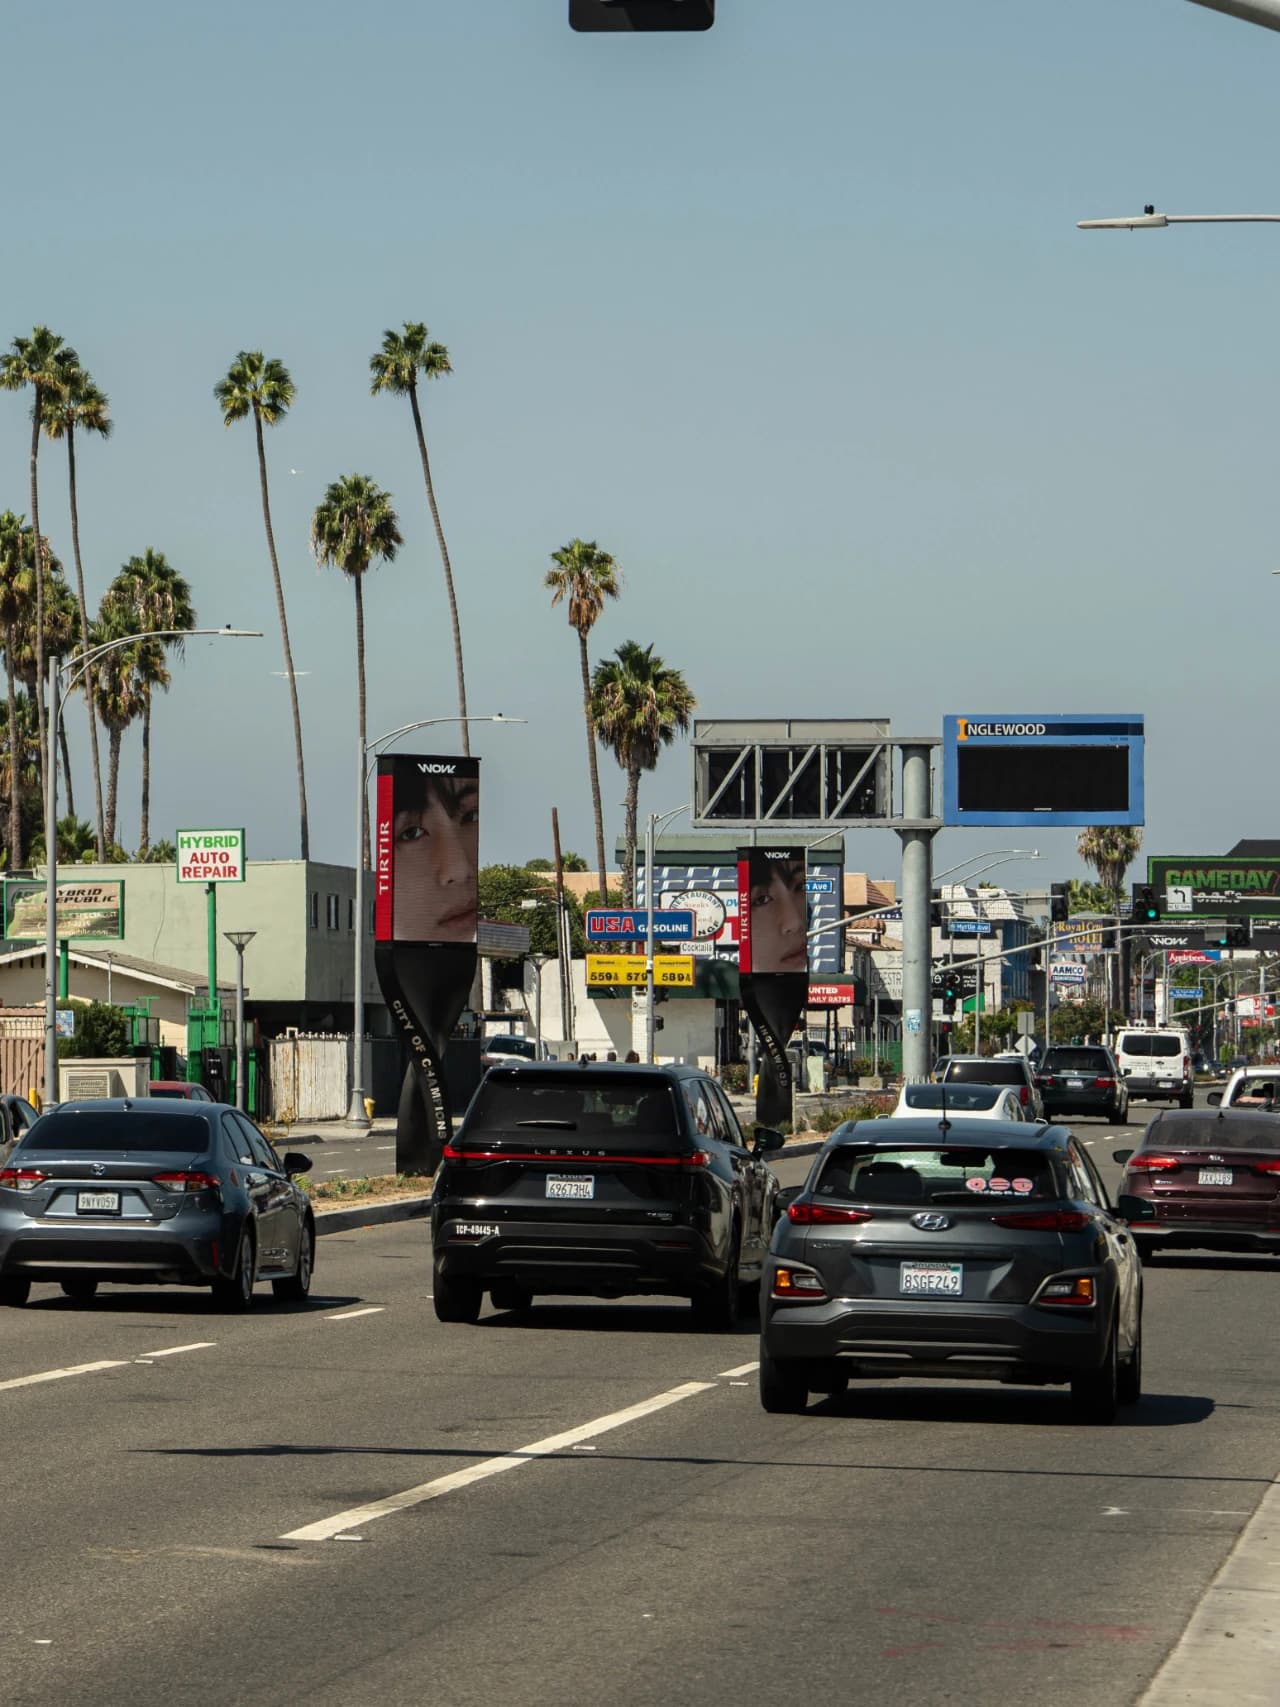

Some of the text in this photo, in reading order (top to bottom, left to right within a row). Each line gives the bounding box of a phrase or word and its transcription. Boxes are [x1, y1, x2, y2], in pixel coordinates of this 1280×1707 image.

[956, 719, 1046, 741] INGLEWOOD
[180, 835, 239, 849] HYBRID
[190, 851, 230, 864] AUTO
[379, 822, 390, 896] TIRTIR
[182, 866, 238, 879] REPAIR
[1166, 869, 1274, 889] GAMEDAY
[590, 916, 635, 933] USA
[740, 892, 748, 942] TIRTIR
[682, 943, 713, 952] Cocktails
[590, 972, 685, 981] 559 579 589
[1053, 966, 1083, 974] AAMCO
[393, 1000, 414, 1030] CITY
[411, 1035, 426, 1052] OF
[549, 1183, 590, 1196] 69673H4
[904, 1274, 959, 1290] 8SGE249
